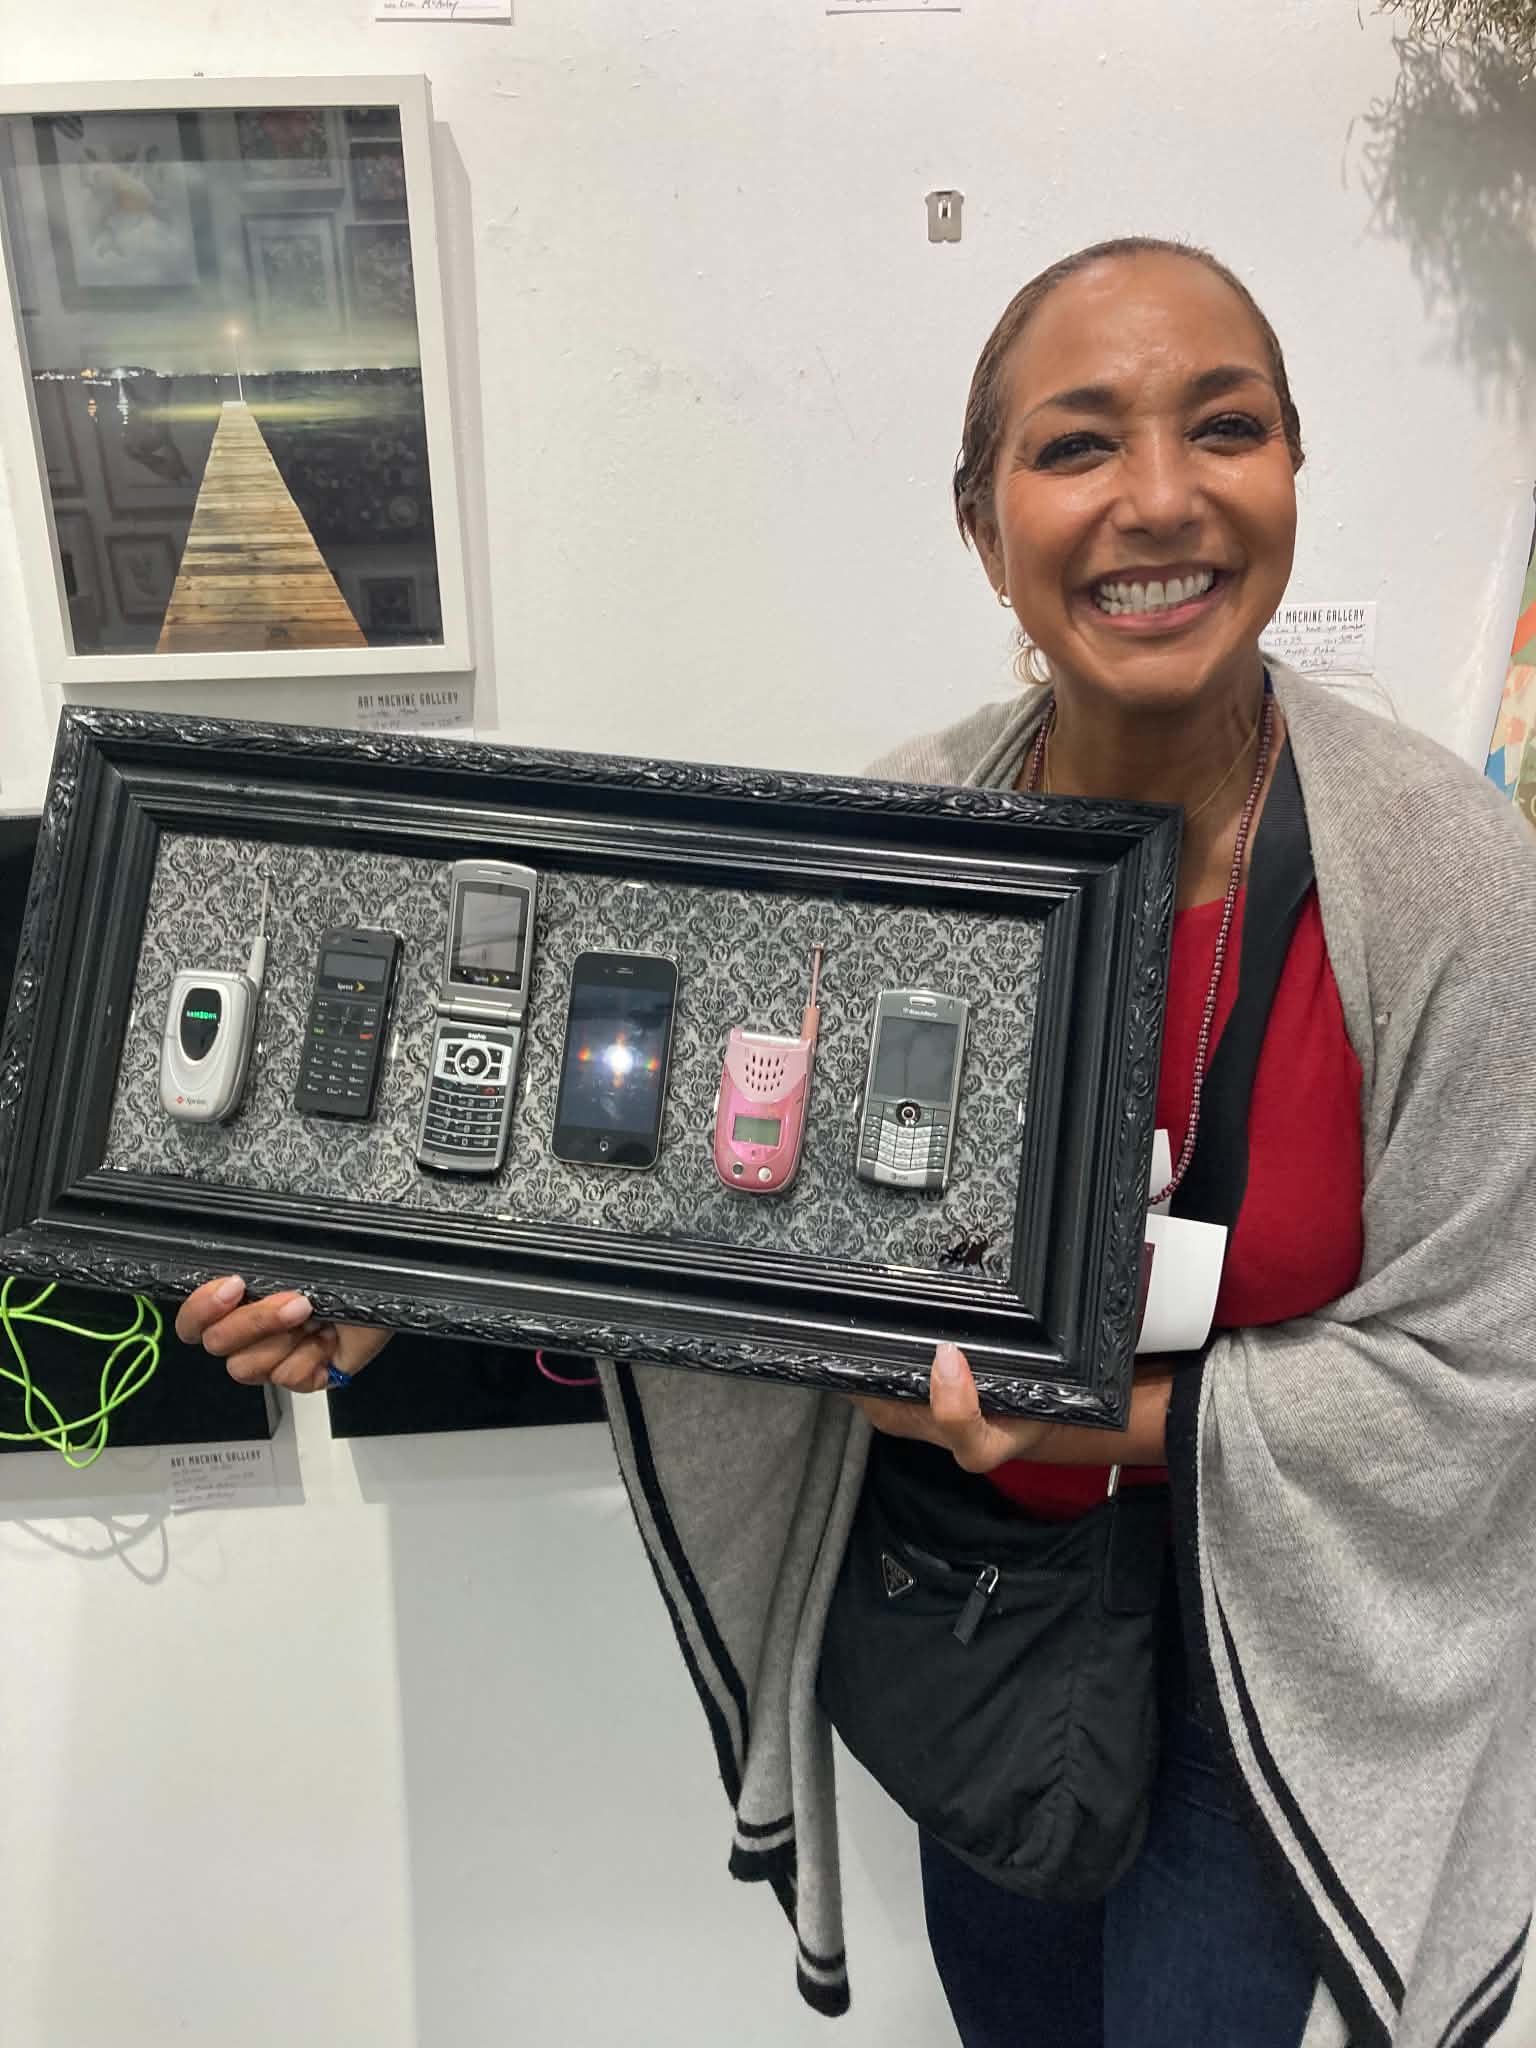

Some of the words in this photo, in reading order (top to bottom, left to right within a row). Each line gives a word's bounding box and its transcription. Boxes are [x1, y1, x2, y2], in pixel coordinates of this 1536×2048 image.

[1286, 608, 1322, 625] MACHINE
[1326, 608, 1364, 623] GALLERY
[358, 695, 374, 708] ART
[378, 693, 416, 707] MACHINE
[419, 691, 458, 705] GALLERY
